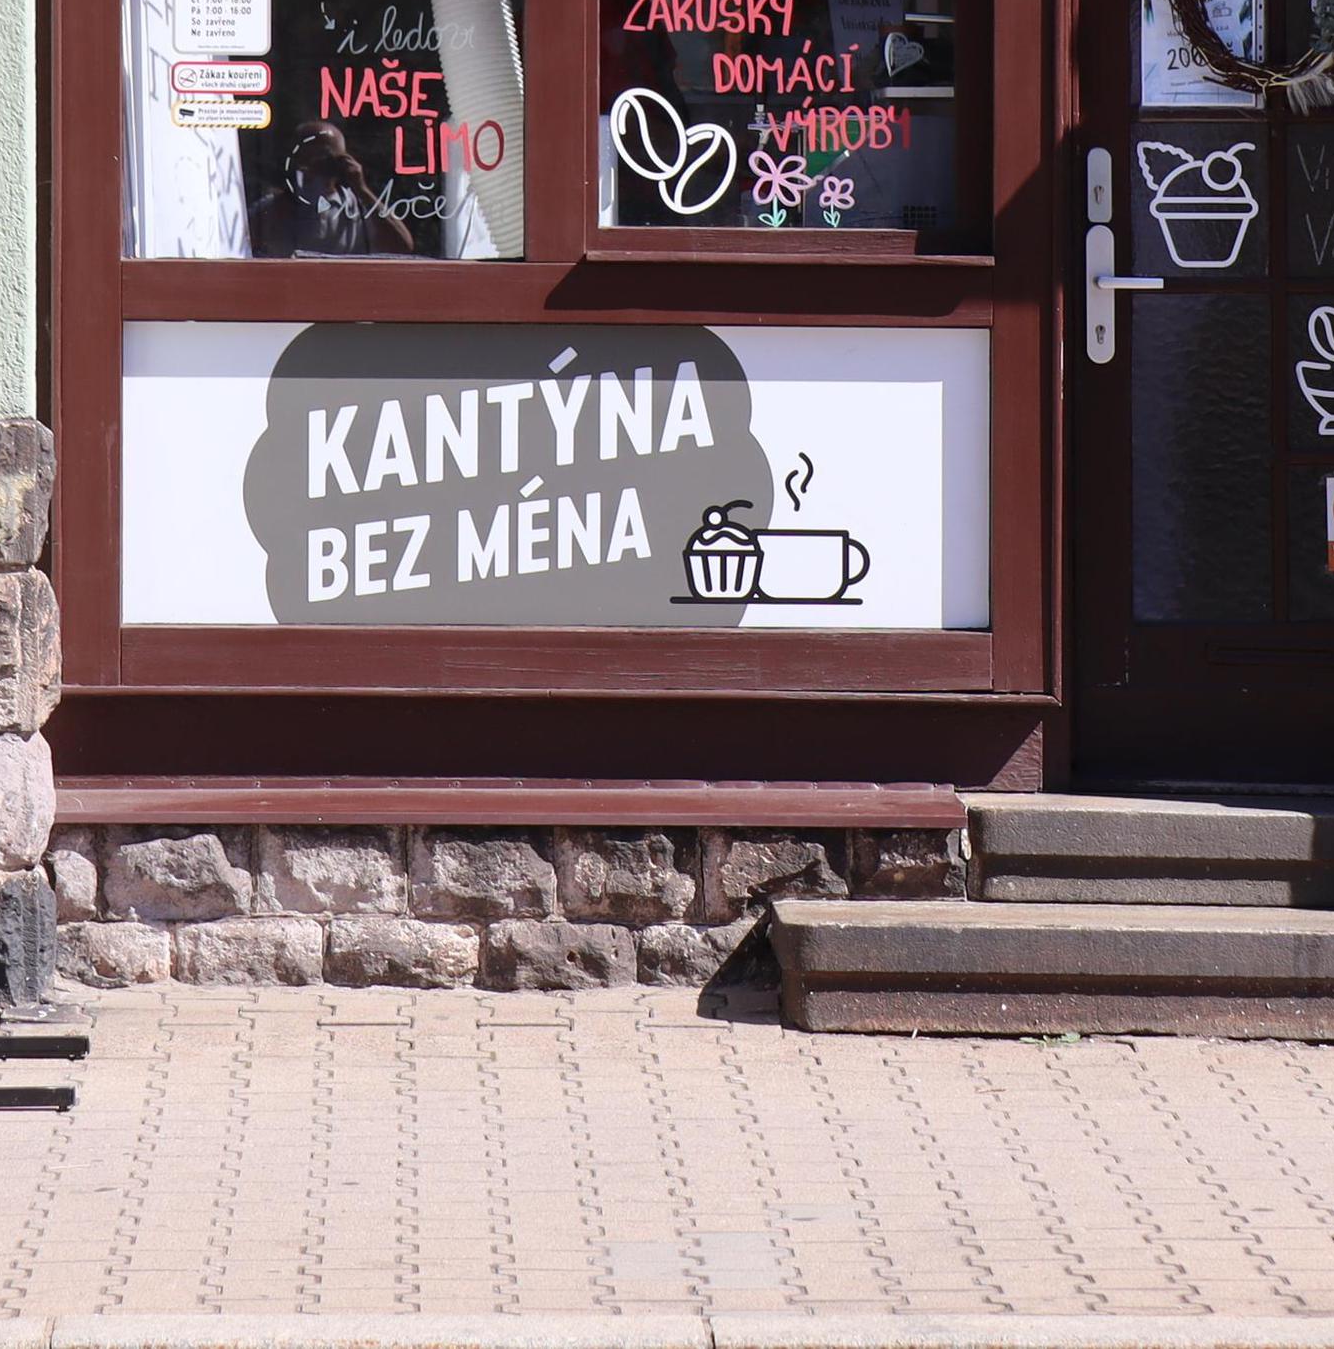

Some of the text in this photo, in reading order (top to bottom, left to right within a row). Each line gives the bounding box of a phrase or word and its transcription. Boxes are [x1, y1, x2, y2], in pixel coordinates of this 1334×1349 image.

[200, 68, 262, 79] Zákaz kouření
[320, 58, 444, 119] NAŠE
[713, 39, 859, 94] DOMÁCÍ
[767, 96, 910, 151] VÝROBY
[308, 346, 714, 499] KANTÝNA
[308, 475, 651, 602] BEZ MÉNA
